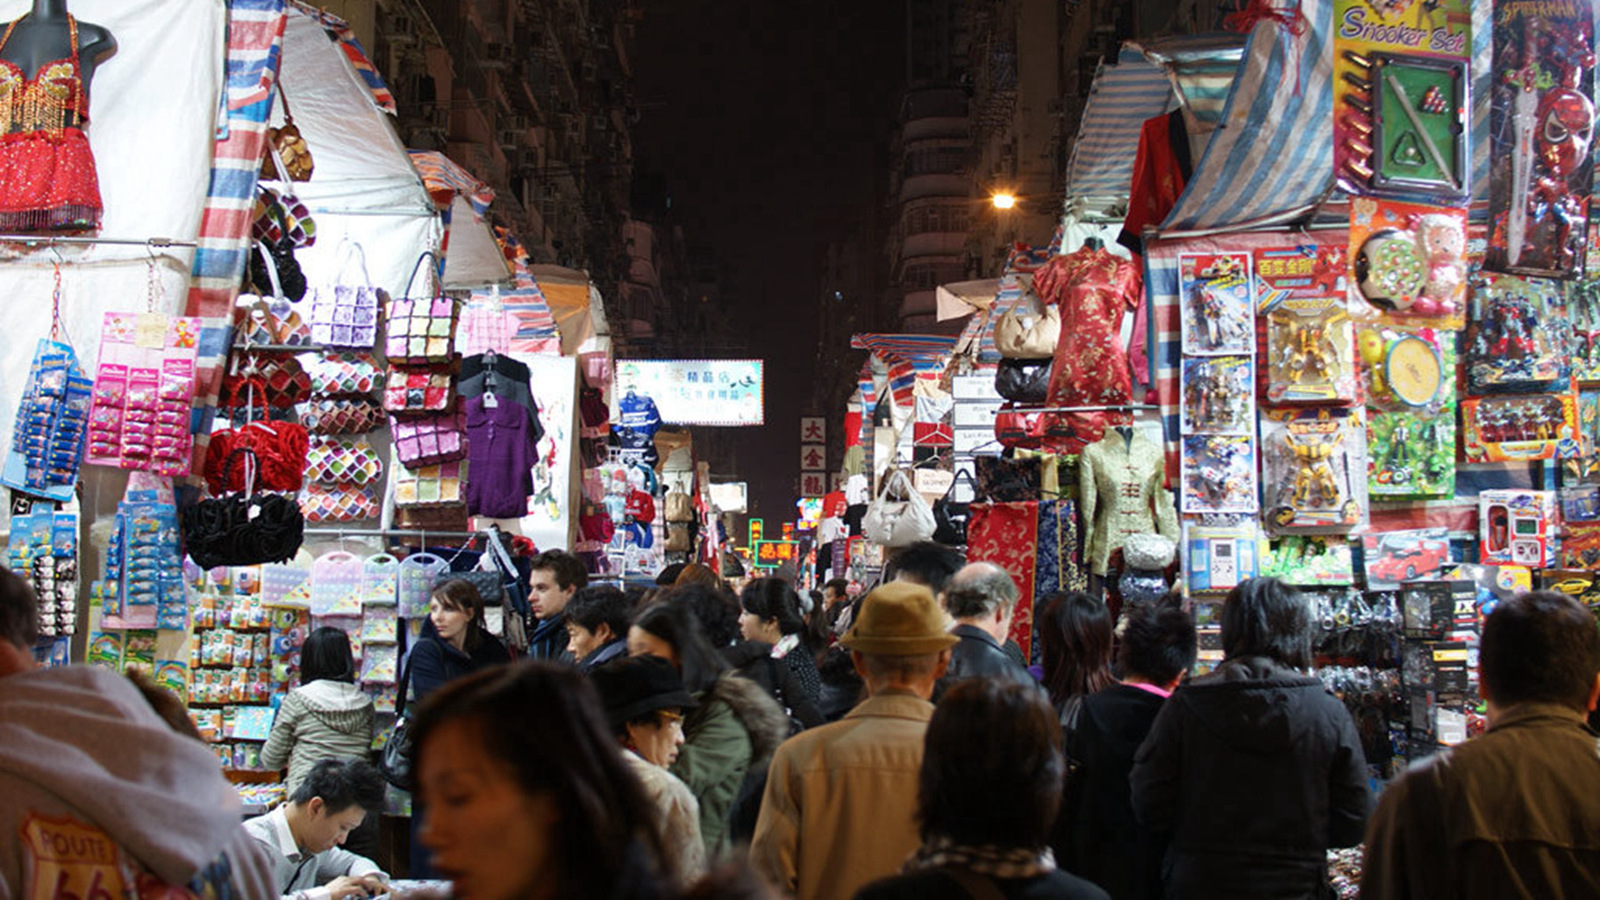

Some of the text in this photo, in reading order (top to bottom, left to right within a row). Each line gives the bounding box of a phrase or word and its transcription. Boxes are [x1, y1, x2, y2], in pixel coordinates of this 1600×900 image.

[1341, 7, 1464, 53] Snooker Set
[804, 420, 823, 495] 大金龍
[41, 829, 105, 858] ROUTE
